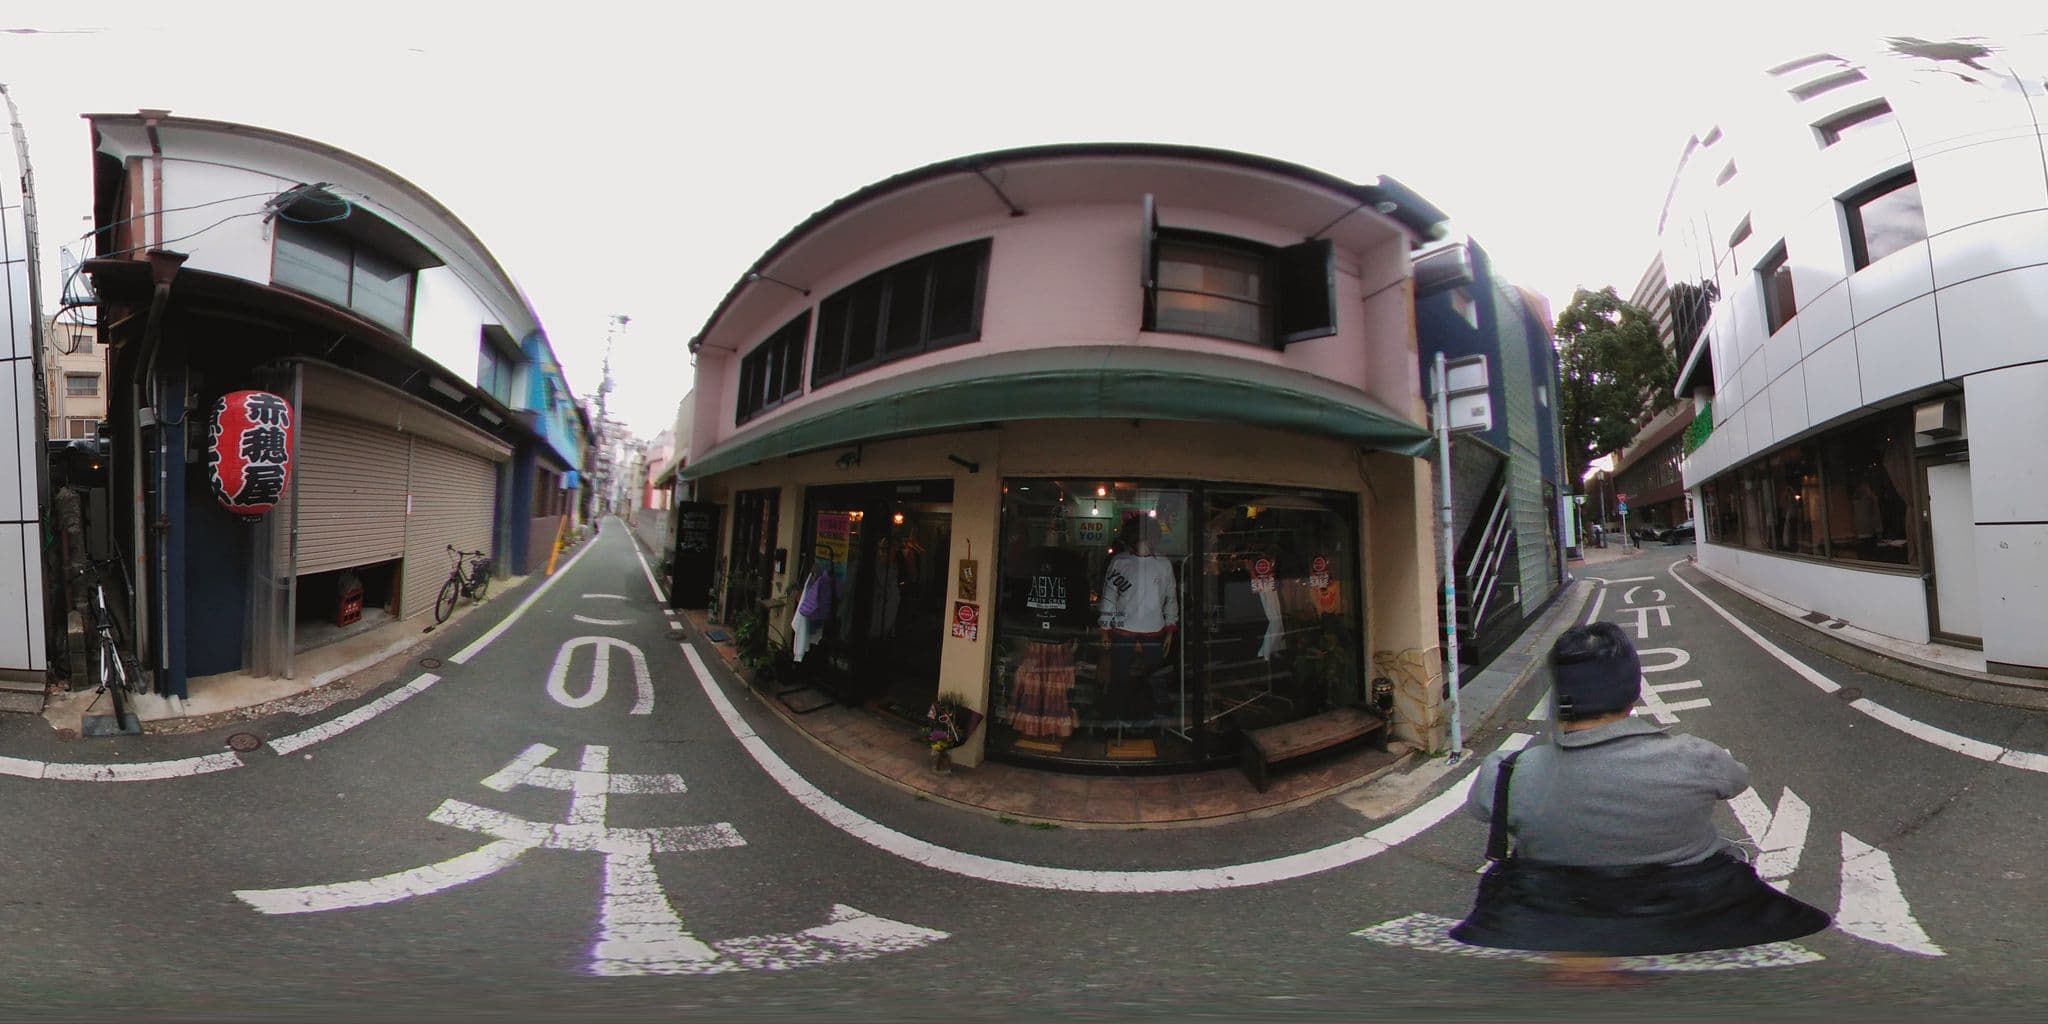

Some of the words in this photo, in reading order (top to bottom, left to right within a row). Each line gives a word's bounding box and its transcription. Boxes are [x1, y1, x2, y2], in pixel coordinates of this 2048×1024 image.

[232, 393, 290, 507] 赤穂屋
[1080, 522, 1104, 531] AND
[1080, 531, 1104, 541] YOU
[1107, 568, 1132, 592] YOU
[232, 594, 951, 976] この先
